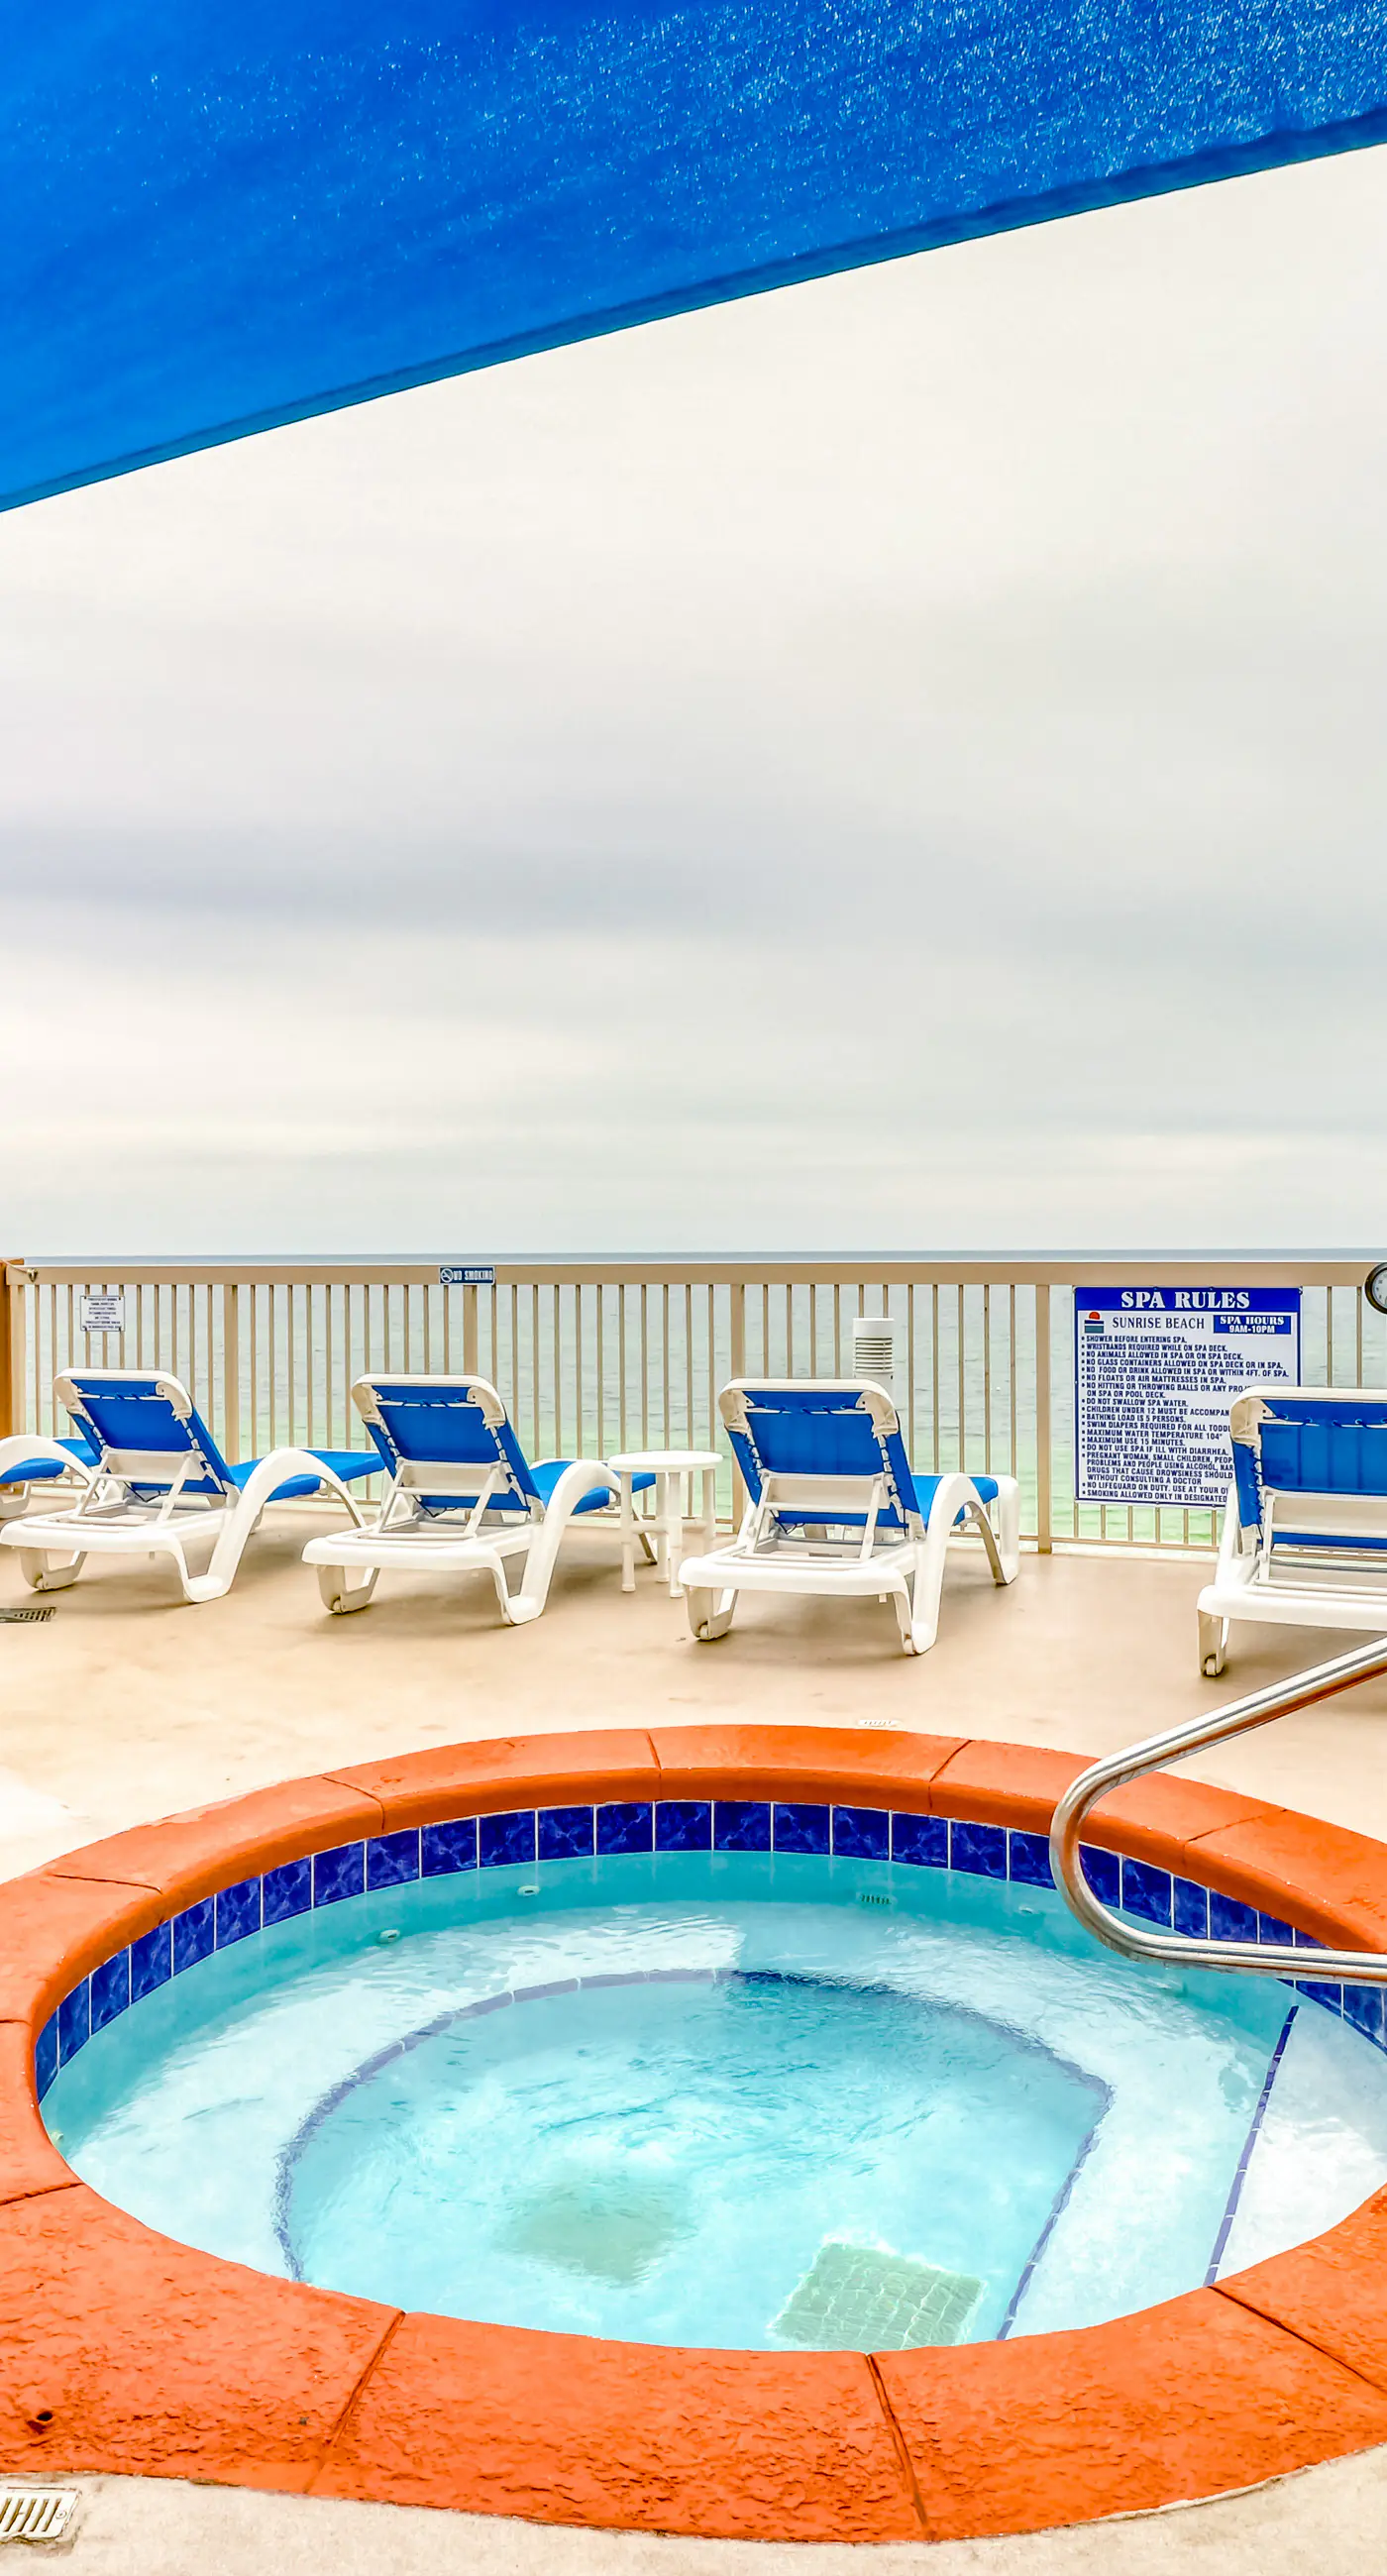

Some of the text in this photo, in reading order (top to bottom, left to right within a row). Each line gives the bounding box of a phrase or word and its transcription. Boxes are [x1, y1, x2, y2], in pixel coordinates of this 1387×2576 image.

[465, 1270, 493, 1281] SMOKING
[1121, 1292, 1249, 1309] SPA RULES
[1113, 1317, 1205, 1329] SUNRISE BEACH
